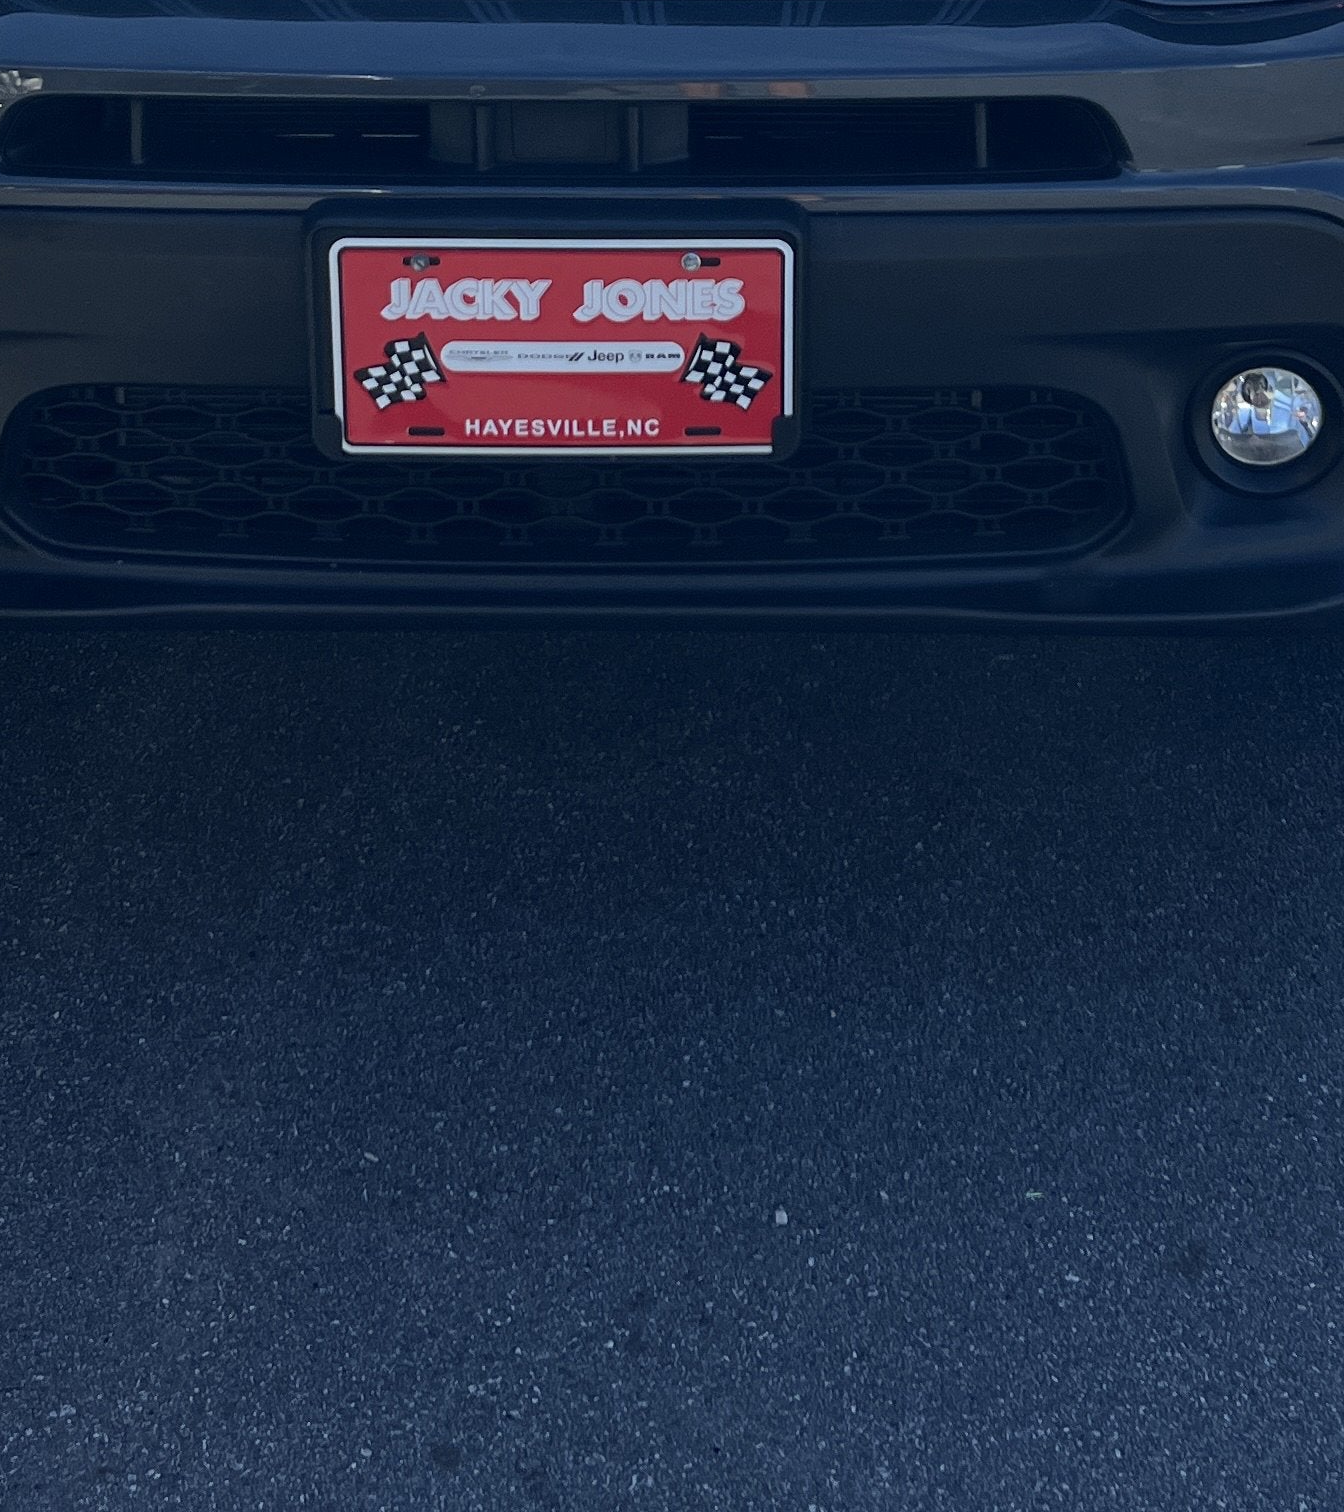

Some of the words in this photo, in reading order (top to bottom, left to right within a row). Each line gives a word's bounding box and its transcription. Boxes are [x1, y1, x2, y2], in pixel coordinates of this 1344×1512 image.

[380, 277, 553, 321] JACKY
[572, 278, 746, 322] JONES
[587, 349, 625, 363] Jeep
[464, 418, 661, 438] HAYESVILLE,NC
